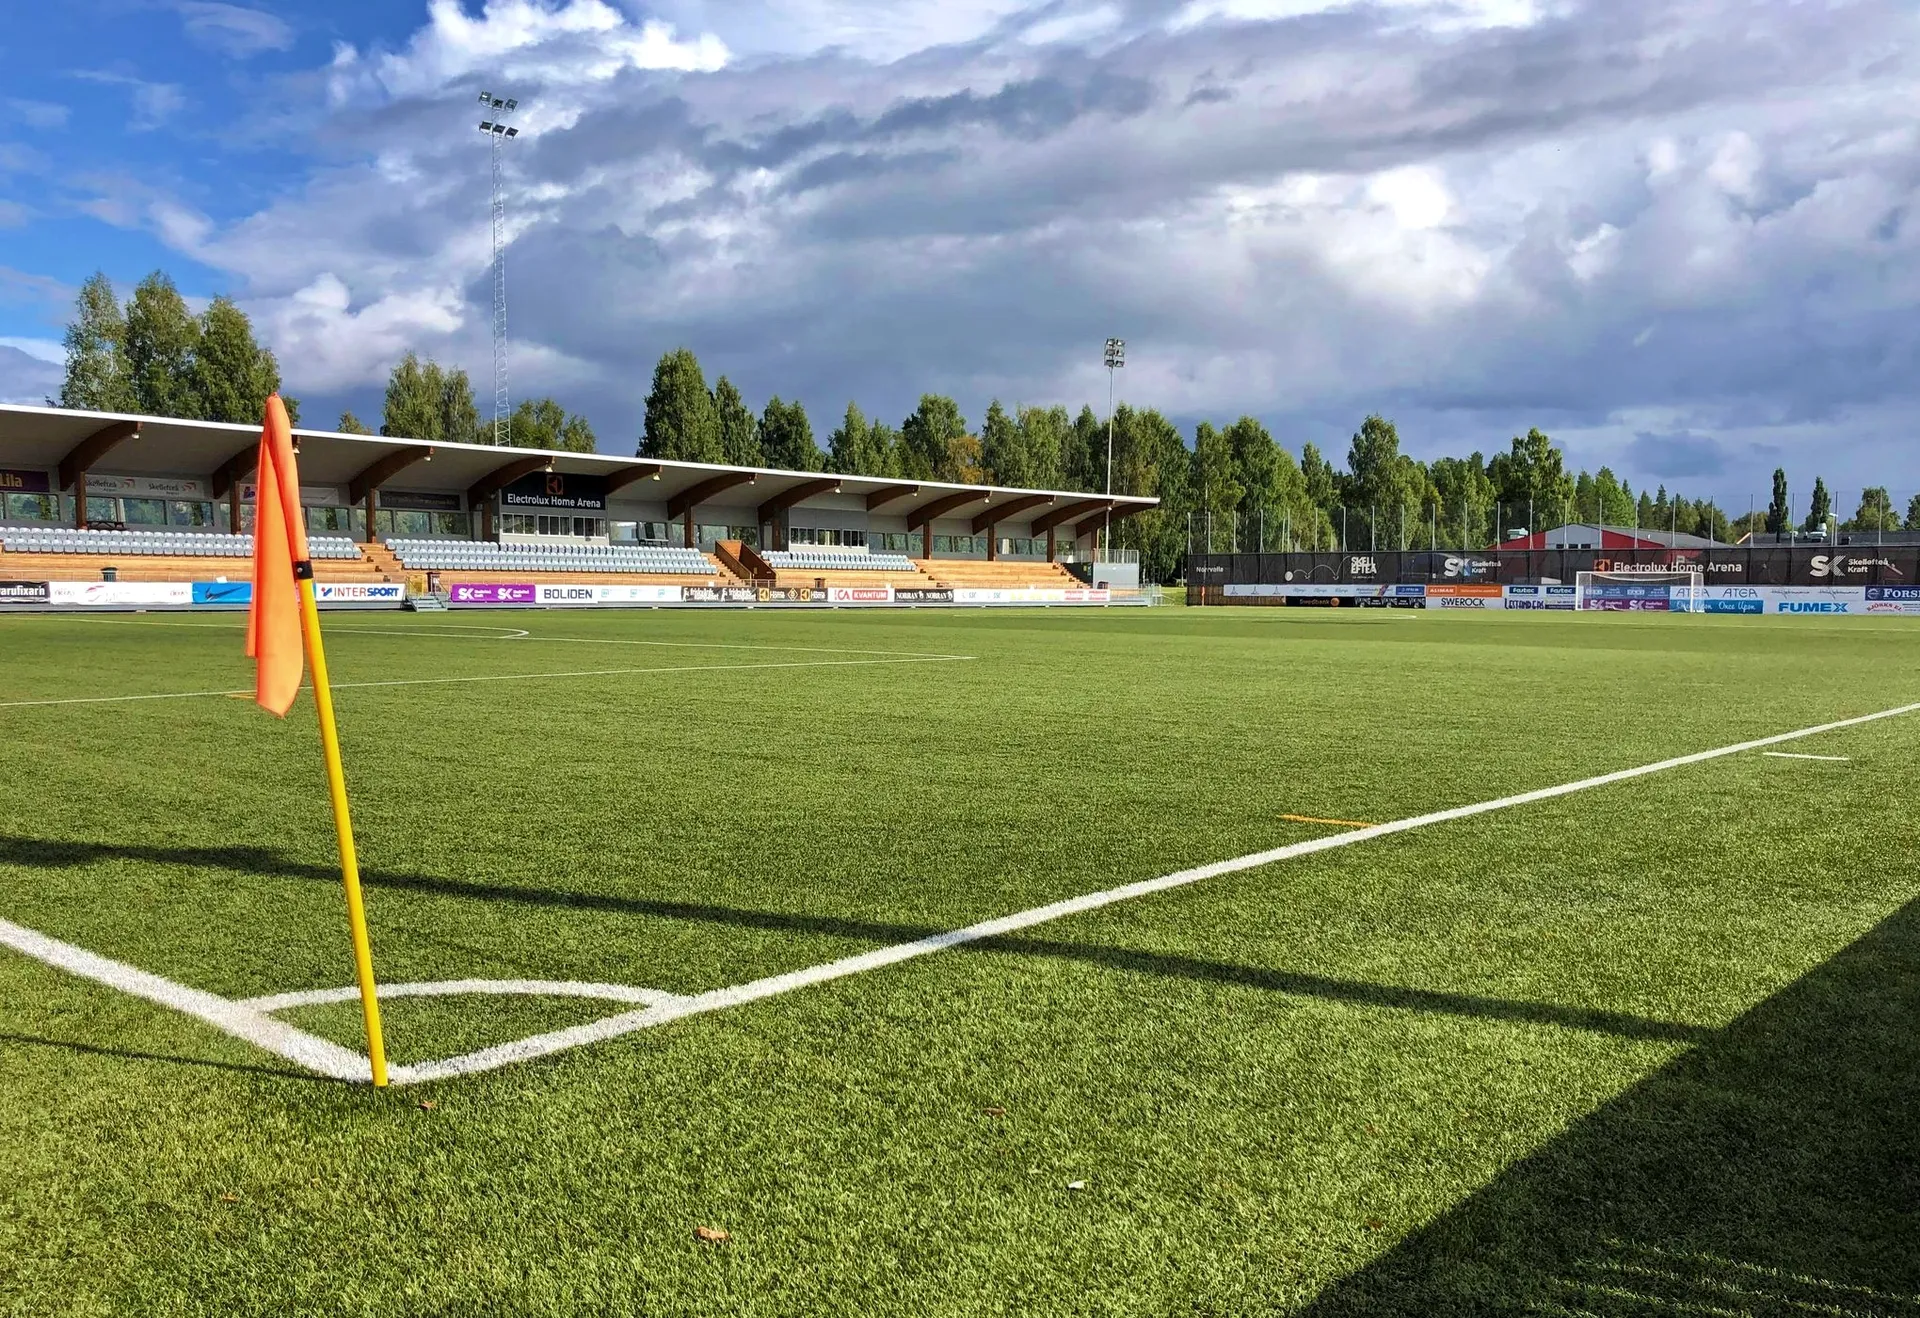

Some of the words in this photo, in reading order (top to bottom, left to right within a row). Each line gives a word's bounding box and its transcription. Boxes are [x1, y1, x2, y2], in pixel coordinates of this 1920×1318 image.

[507, 493, 549, 505] Electrolux
[551, 496, 575, 506] Home
[577, 498, 601, 508] Arena
[1809, 555, 1847, 577] SK
[1848, 558, 1887, 566] Skellefteå
[1613, 562, 1667, 573] Electrolux
[1671, 562, 1703, 573] Home
[1707, 562, 1742, 572] Arena
[0, 585, 46, 596] arufixarn
[334, 588, 400, 597] INTERSPORT
[458, 588, 475, 600] SK
[497, 588, 514, 600] SK
[544, 589, 593, 599] BOLIDEN
[854, 591, 887, 600] KVANTUM
[1722, 588, 1758, 598] ATEA
[1441, 598, 1485, 606] SWEROCK
[1718, 602, 1736, 610] Once
[1738, 601, 1756, 612] Upon
[1778, 603, 1848, 612] FUMEX
